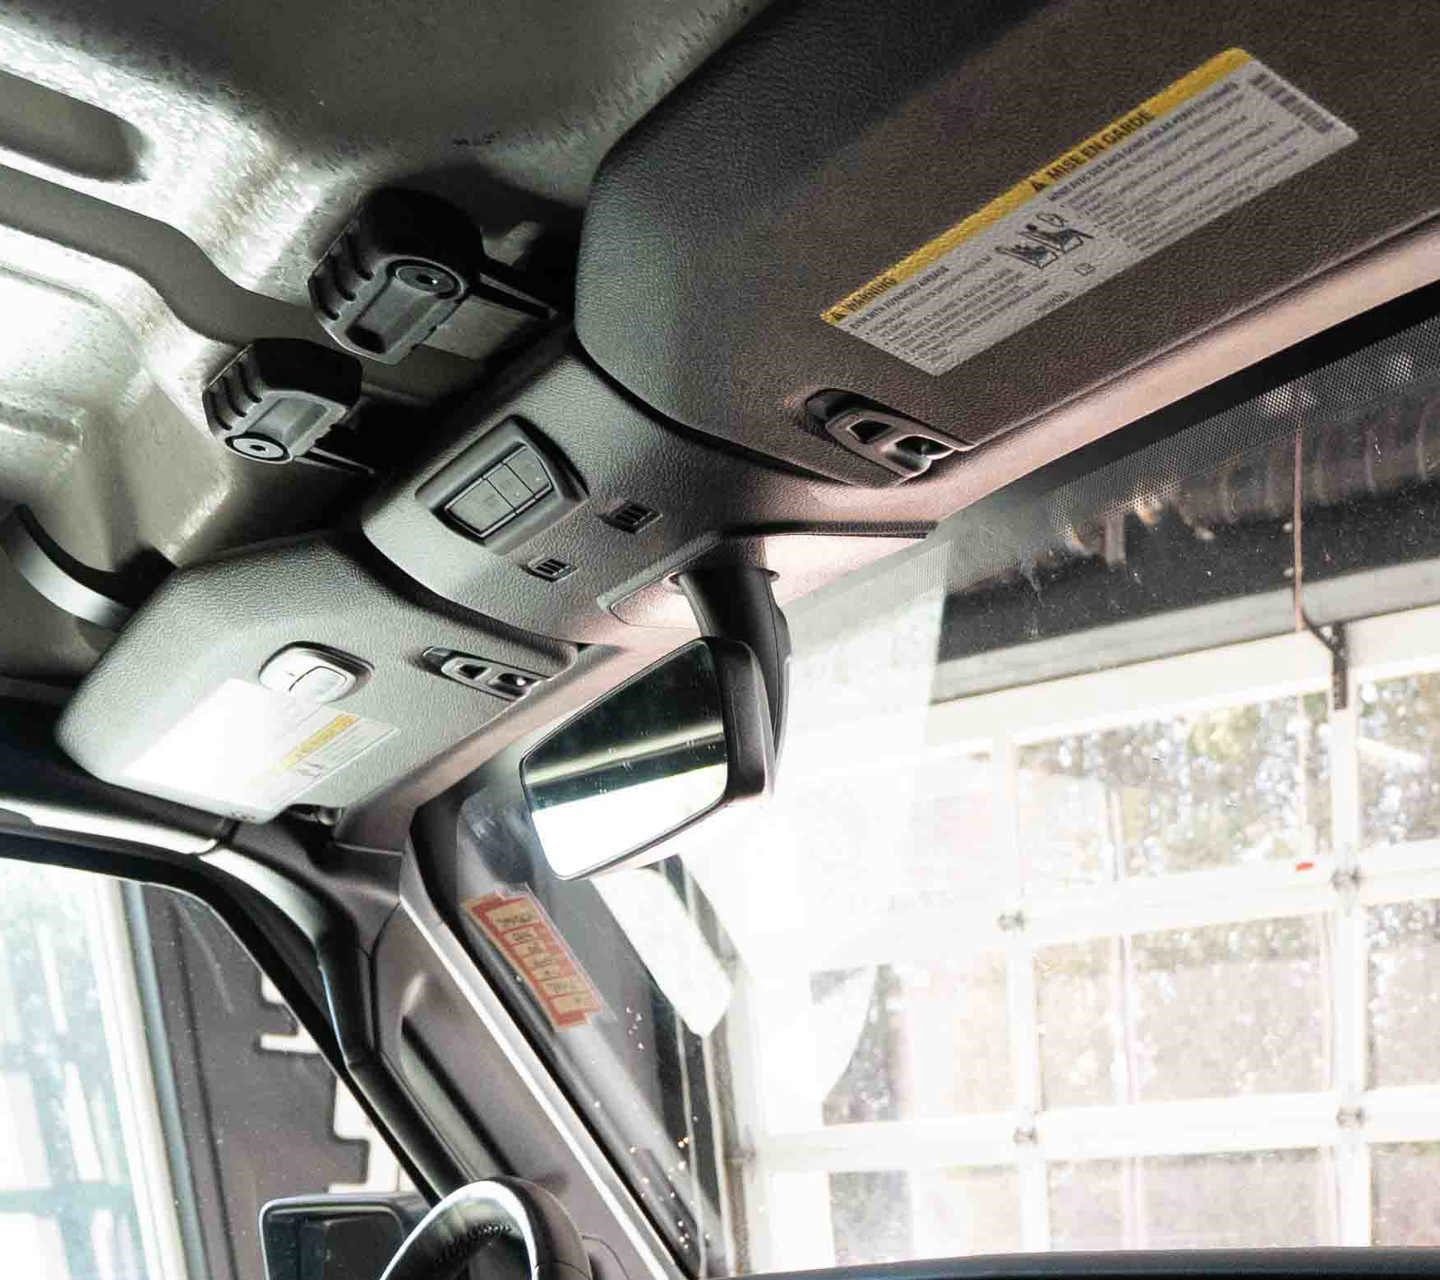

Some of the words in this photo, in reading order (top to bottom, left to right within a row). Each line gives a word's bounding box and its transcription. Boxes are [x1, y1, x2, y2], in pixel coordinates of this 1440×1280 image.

[1048, 151, 1087, 181] MISE
[1085, 141, 1105, 160] EN
[1102, 110, 1155, 146] GARDE
[847, 276, 898, 312] WARNING
